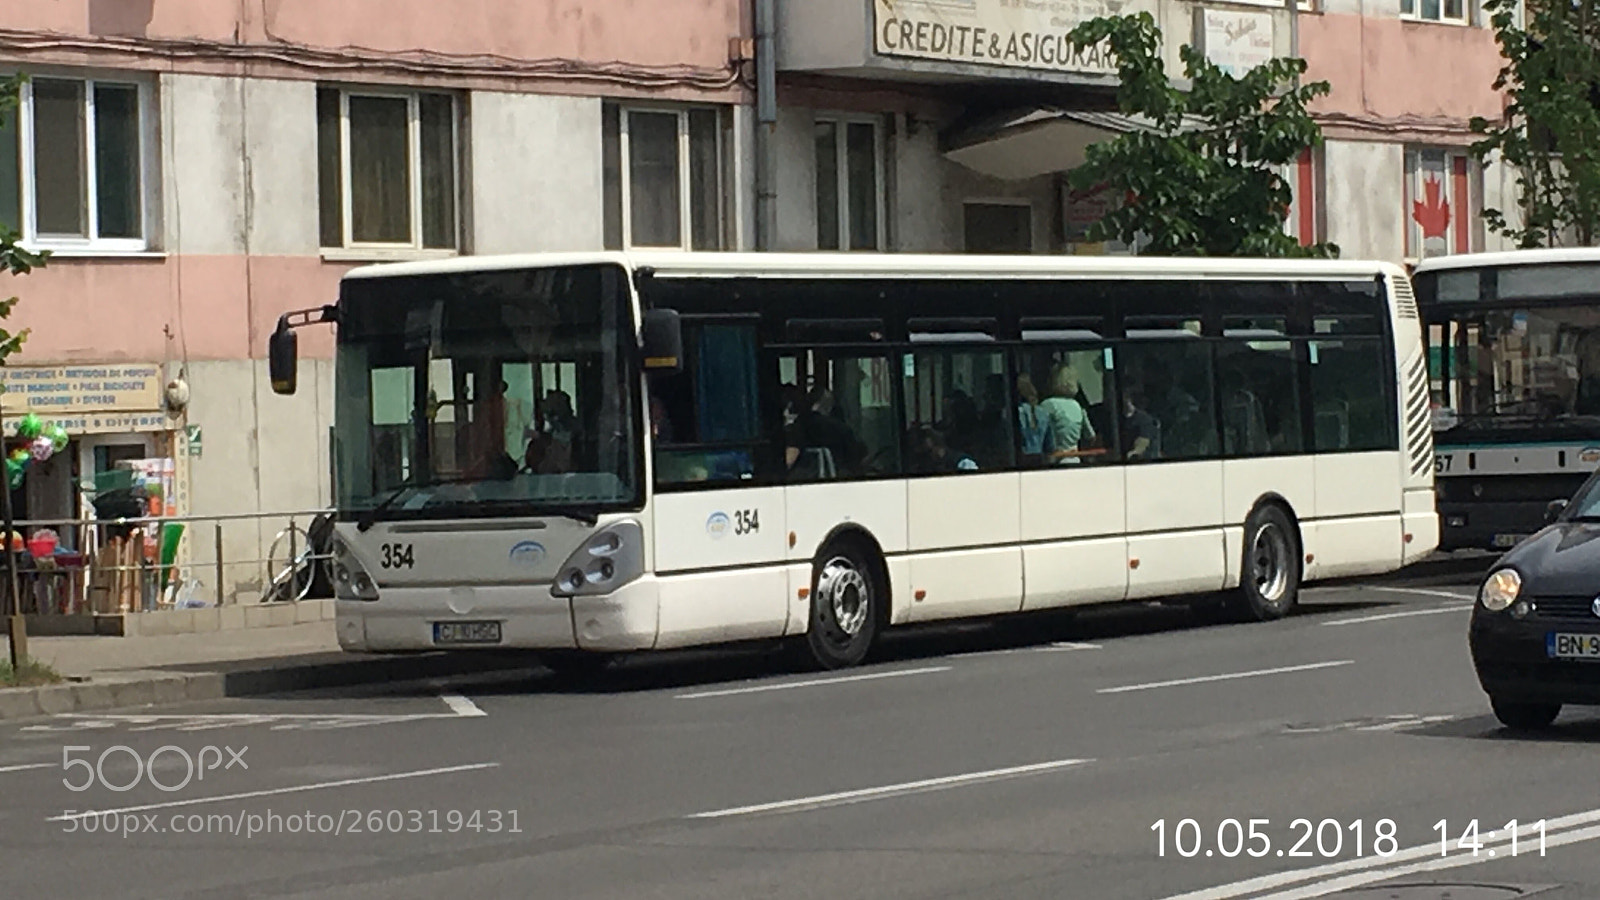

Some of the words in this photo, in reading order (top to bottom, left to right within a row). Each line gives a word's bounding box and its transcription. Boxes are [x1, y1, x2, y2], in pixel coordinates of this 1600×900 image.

[733, 508, 760, 535] 354
[380, 543, 415, 570] 354
[1558, 635, 1583, 655] BN
